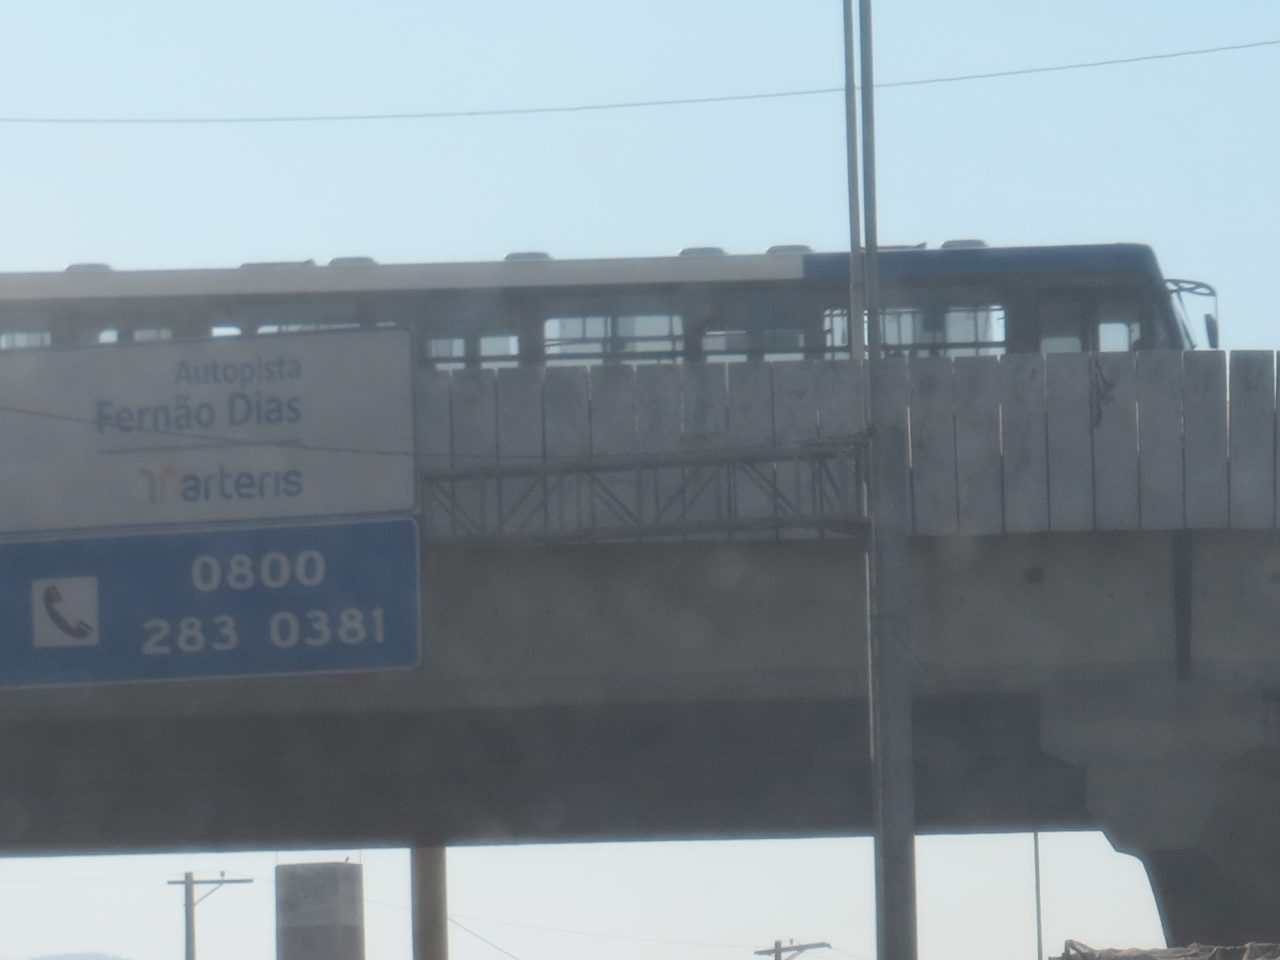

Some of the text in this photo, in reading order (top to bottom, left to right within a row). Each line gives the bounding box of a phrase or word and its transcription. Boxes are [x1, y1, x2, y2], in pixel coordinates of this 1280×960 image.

[175, 355, 303, 388] Autopista
[95, 391, 303, 434] Fernão Dias
[181, 463, 304, 503] arteris
[191, 550, 326, 592] 0800
[142, 607, 385, 655] 283 0381
